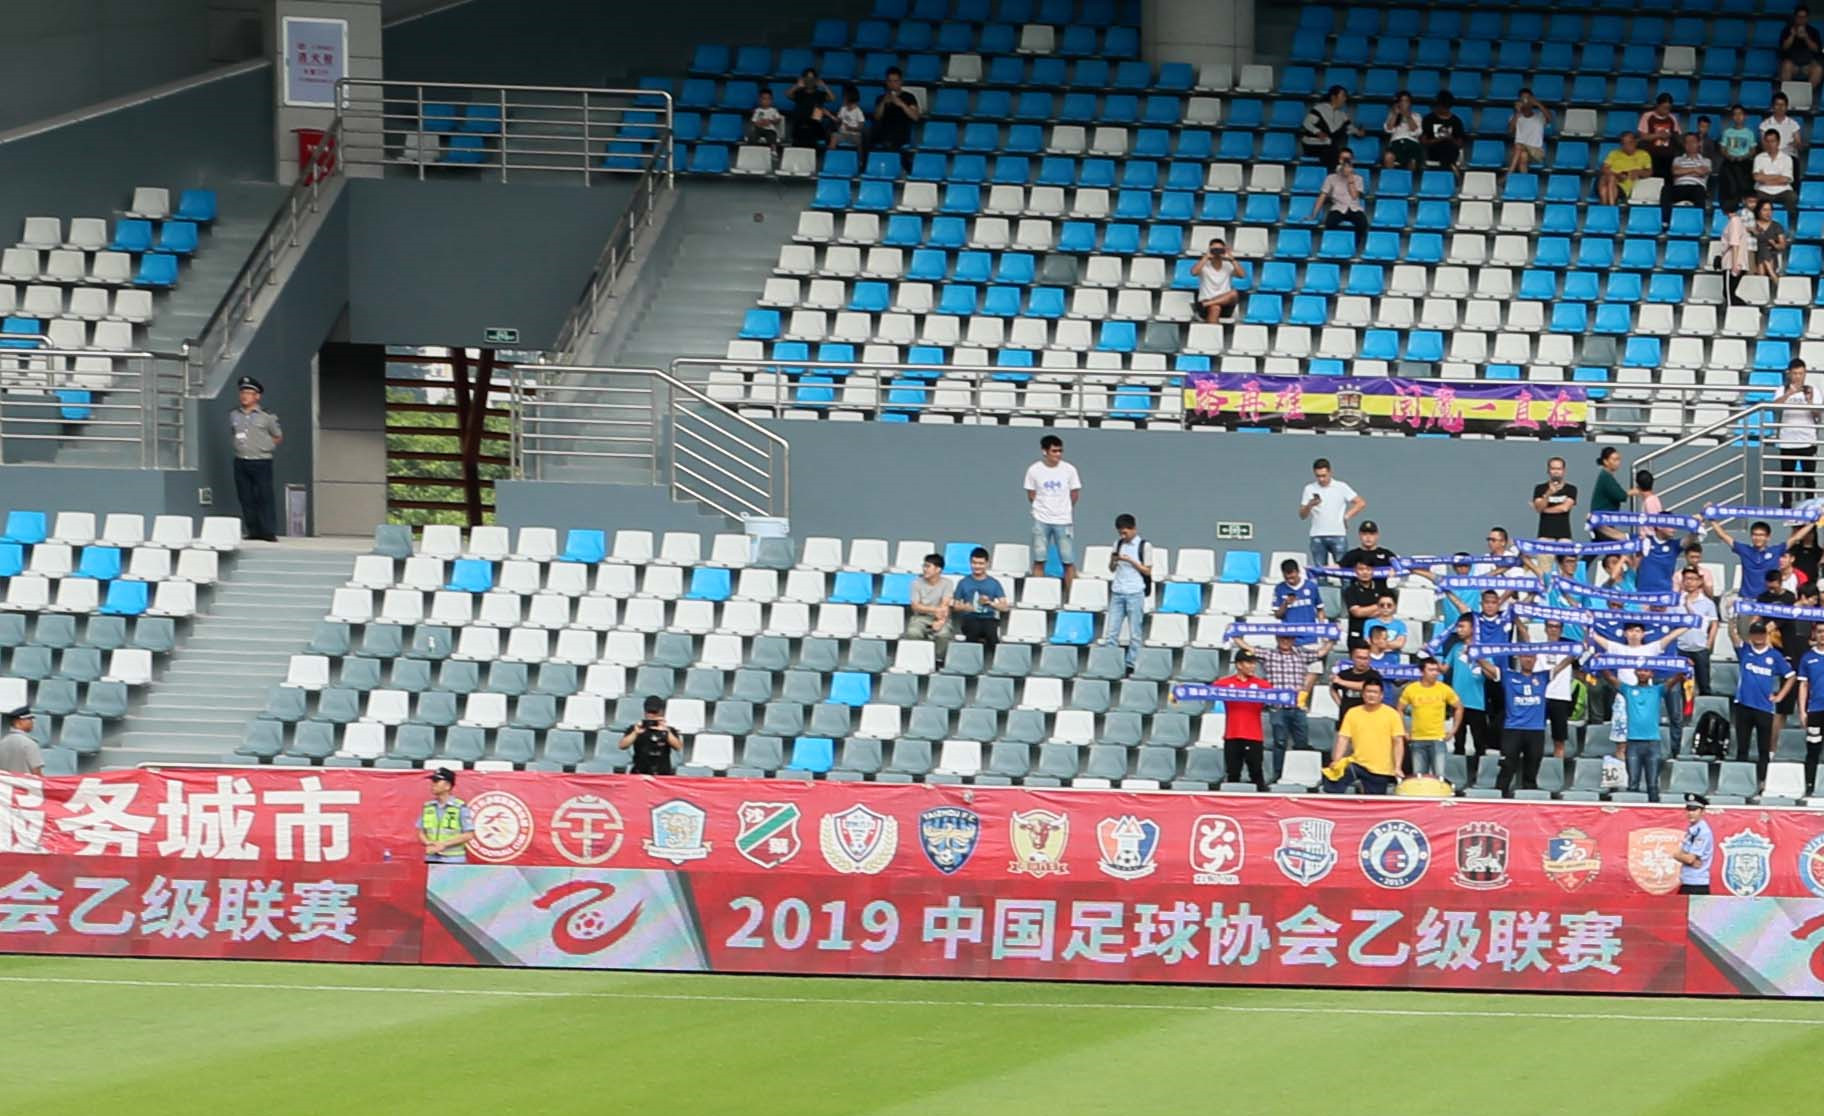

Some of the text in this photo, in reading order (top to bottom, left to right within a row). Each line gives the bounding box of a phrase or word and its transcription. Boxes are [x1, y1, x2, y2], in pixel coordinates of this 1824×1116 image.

[726, 896, 1623, 976] 2019 中国足球协会乙级联赛
